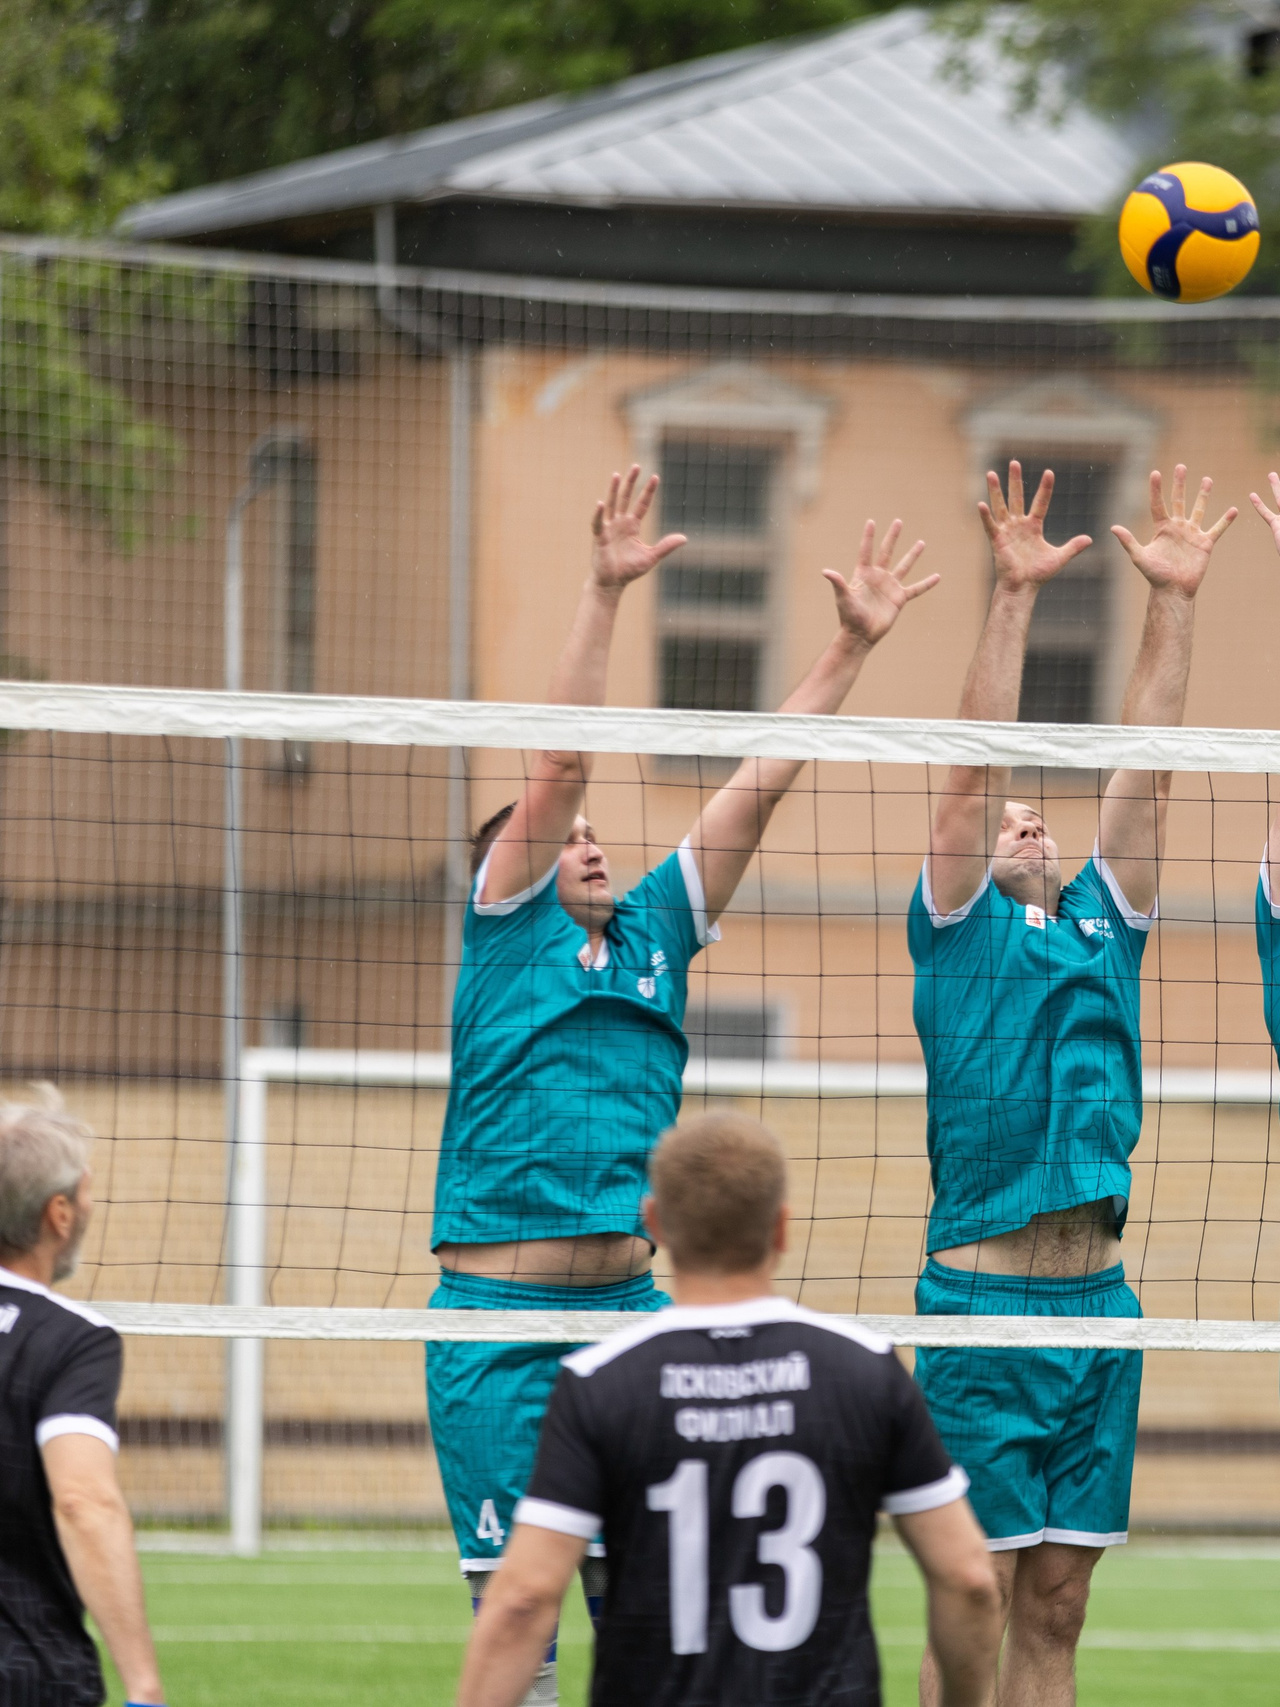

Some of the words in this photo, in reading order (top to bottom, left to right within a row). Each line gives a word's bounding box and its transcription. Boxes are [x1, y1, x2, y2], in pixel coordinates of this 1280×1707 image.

[660, 1351, 811, 1399] ПСКОВСКИЙ
[675, 1400, 796, 1441] ФИЛИАЛ
[476, 1499, 505, 1546] 4
[646, 1450, 827, 1655] 13
